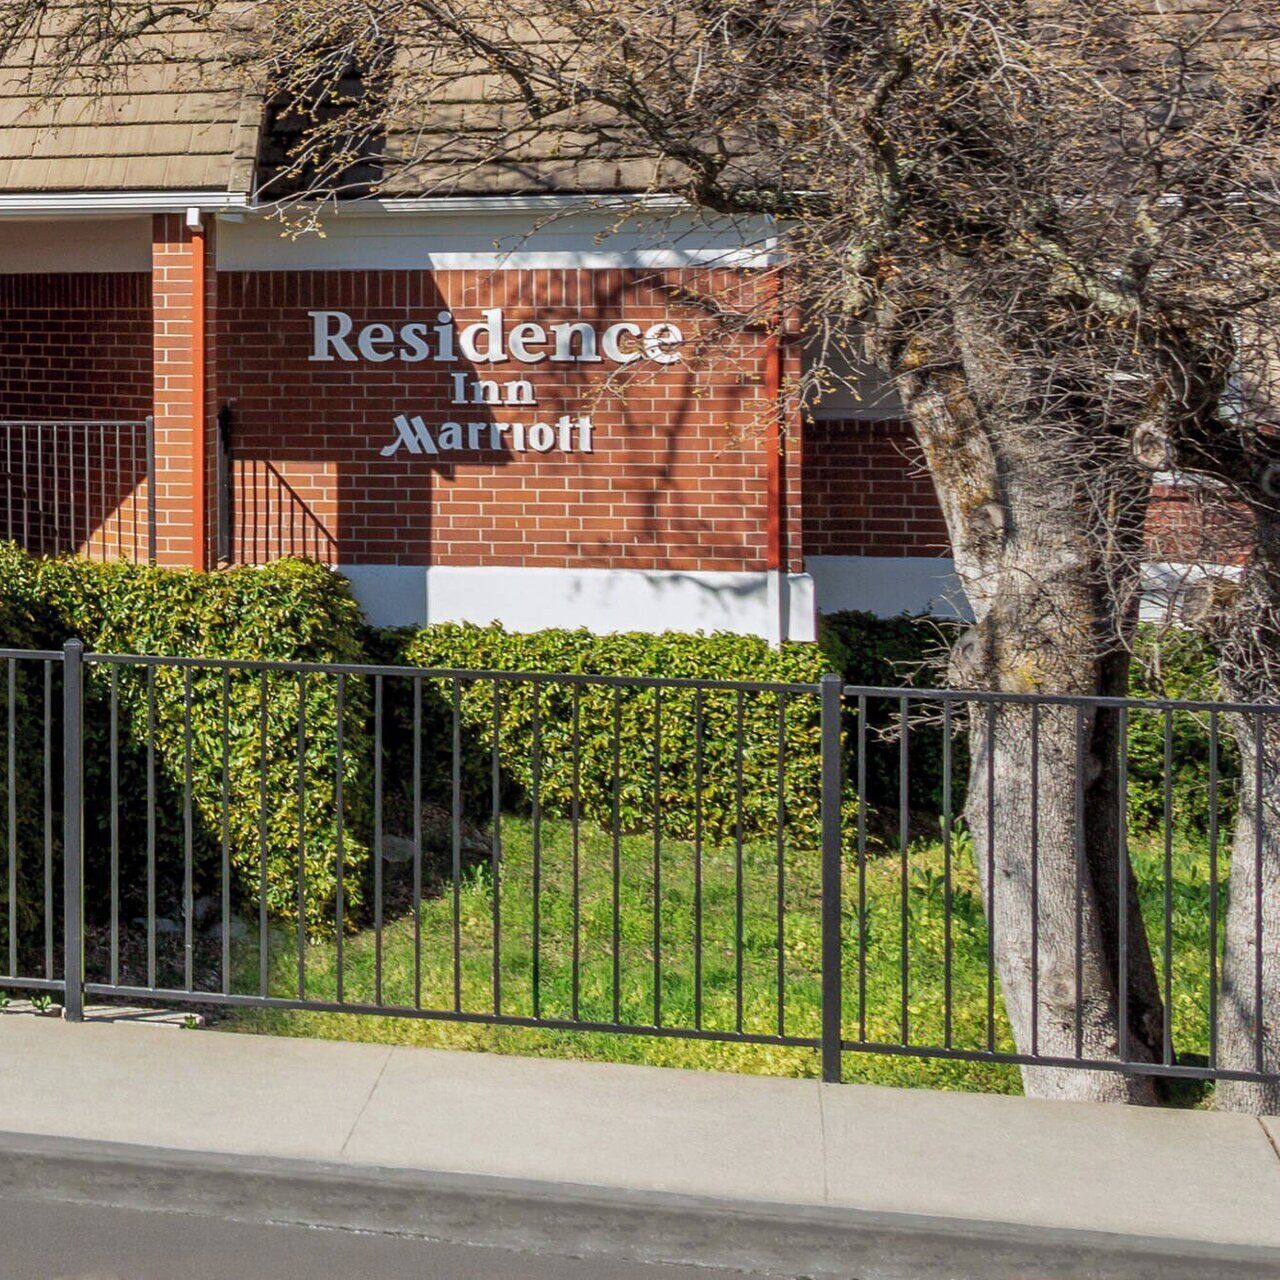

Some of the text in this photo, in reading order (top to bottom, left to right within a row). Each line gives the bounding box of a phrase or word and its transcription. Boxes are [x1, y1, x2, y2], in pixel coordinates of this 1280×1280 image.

[307, 308, 685, 364] Residence
[450, 372, 538, 406] Inn
[379, 414, 594, 456] Marriott
